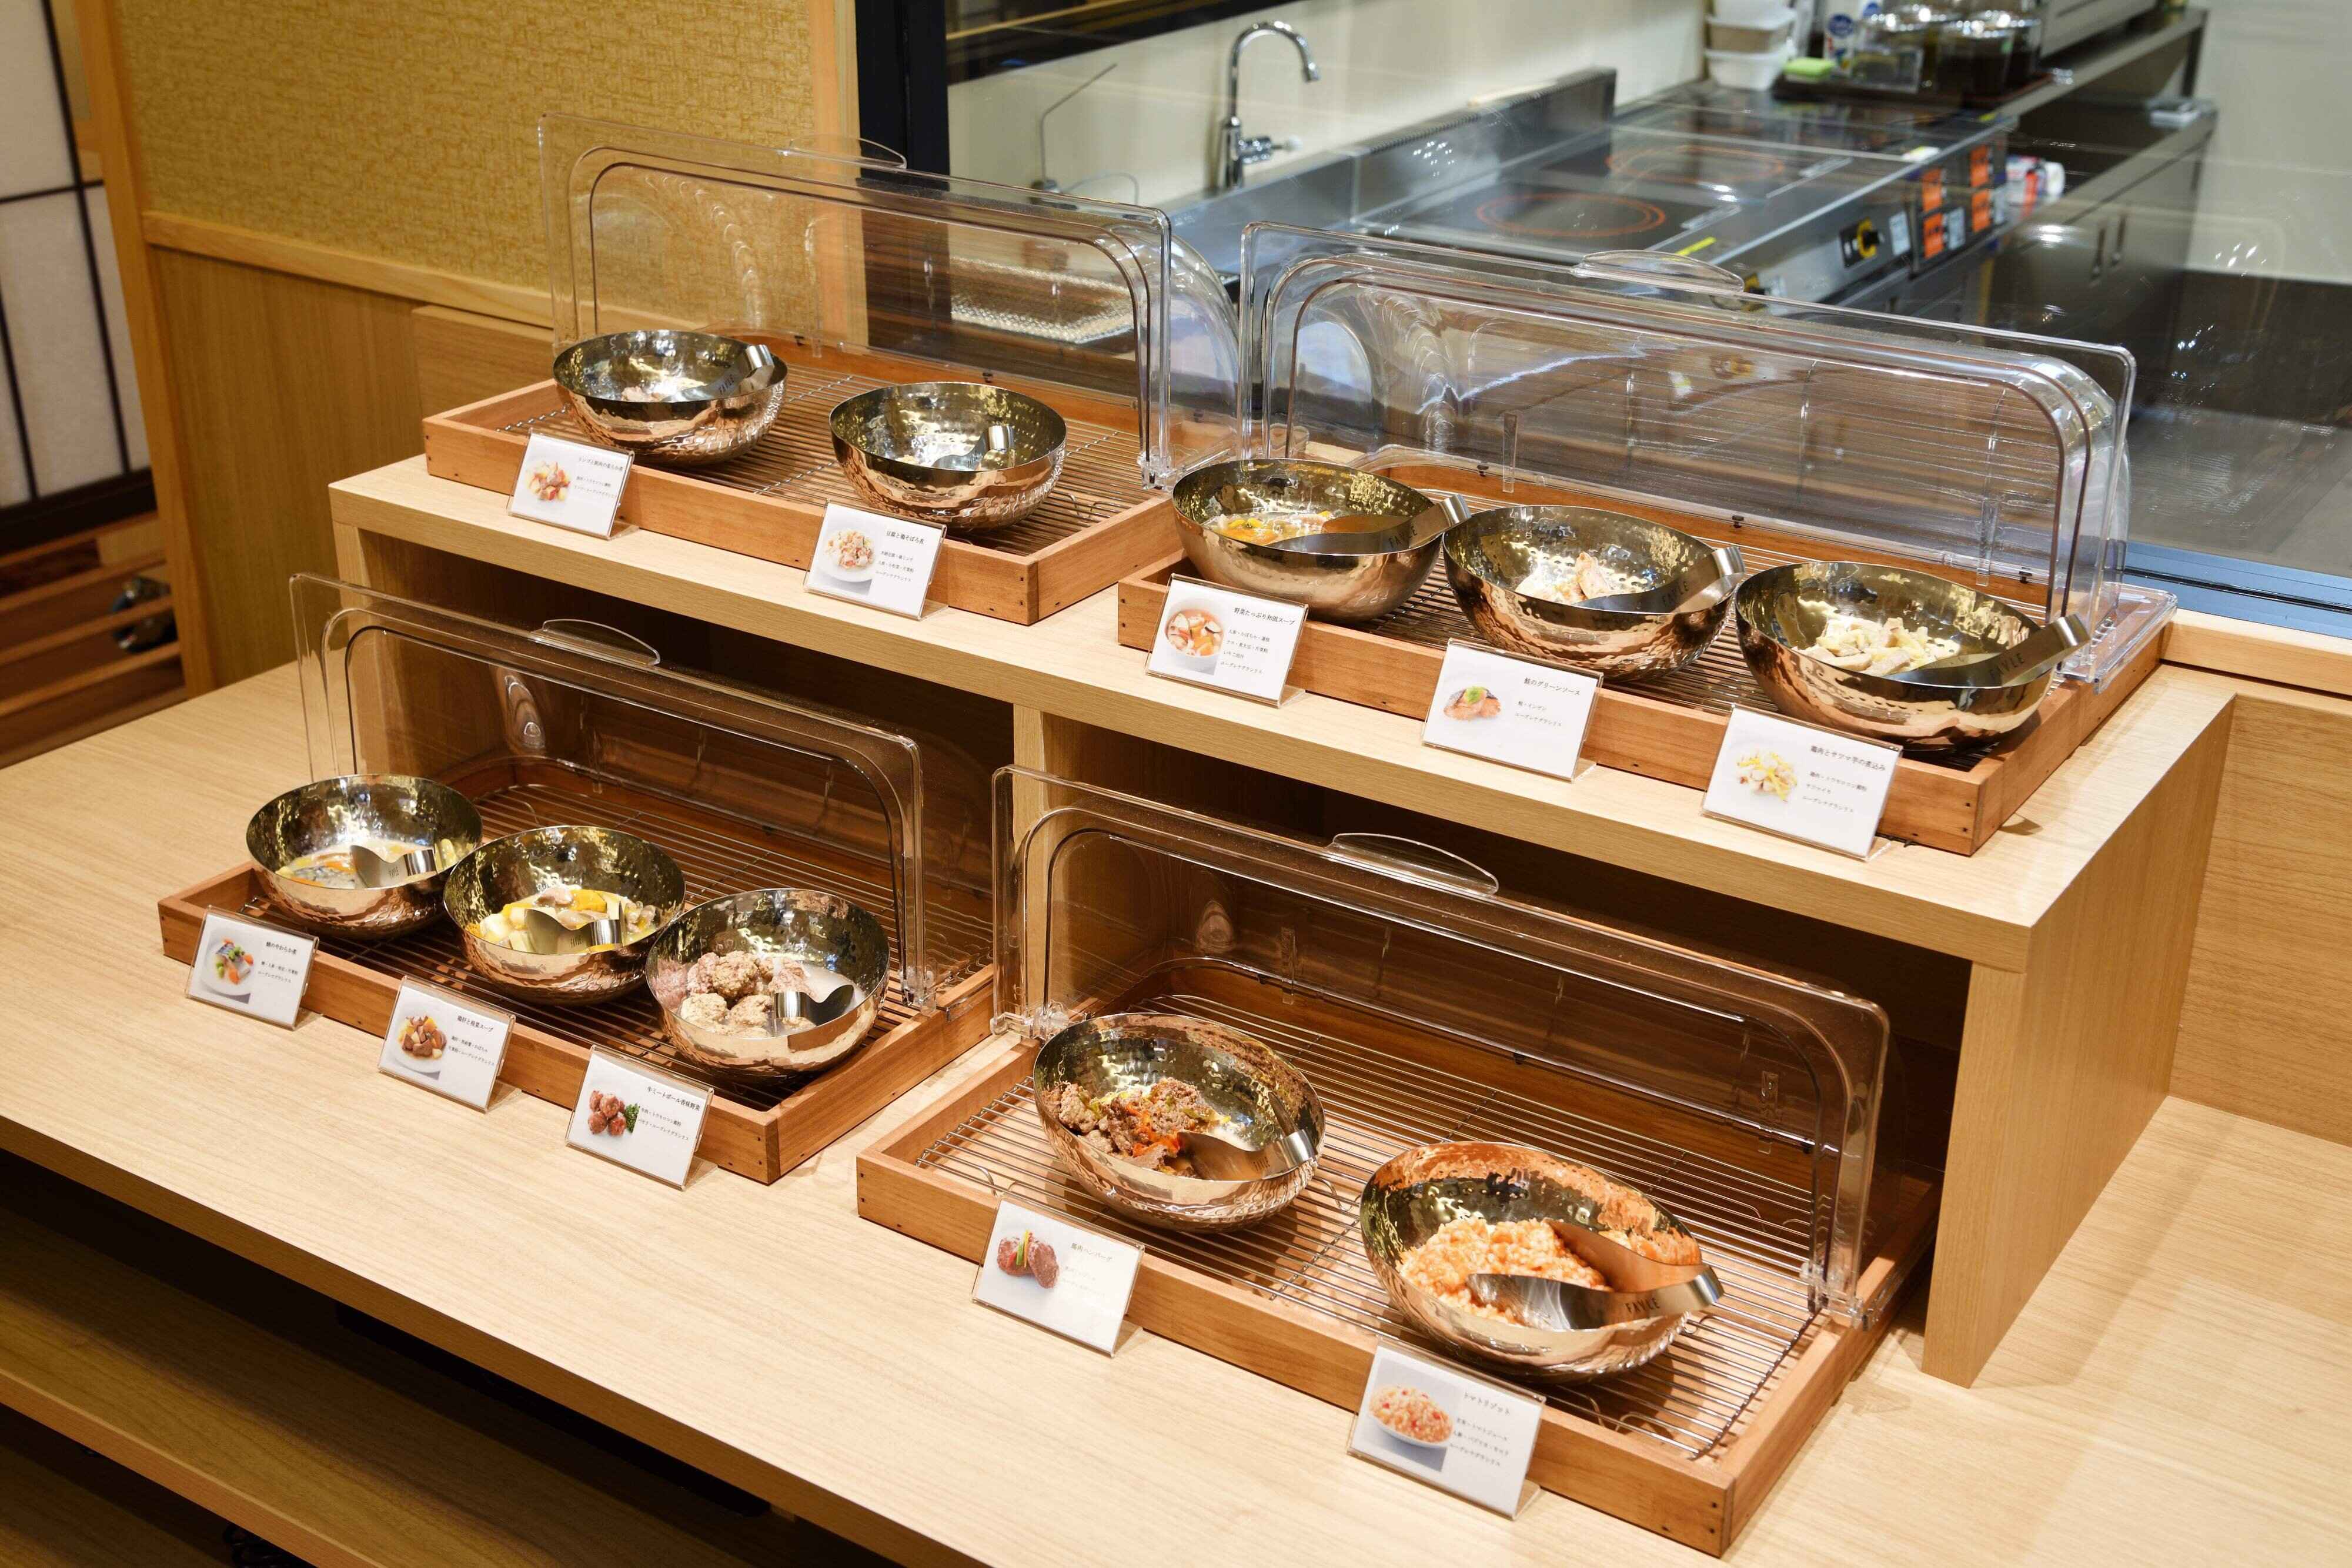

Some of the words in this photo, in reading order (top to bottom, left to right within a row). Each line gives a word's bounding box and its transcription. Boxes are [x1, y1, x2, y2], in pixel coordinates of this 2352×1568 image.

[1234, 607, 1295, 626] 野菜たっぷり和風スープ
[1524, 677, 1580, 696] 鮭のグリーンソース
[647, 1086, 701, 1111] 牛ミートボール香味野菜
[1464, 1392, 1511, 1415] トマトリゾット
